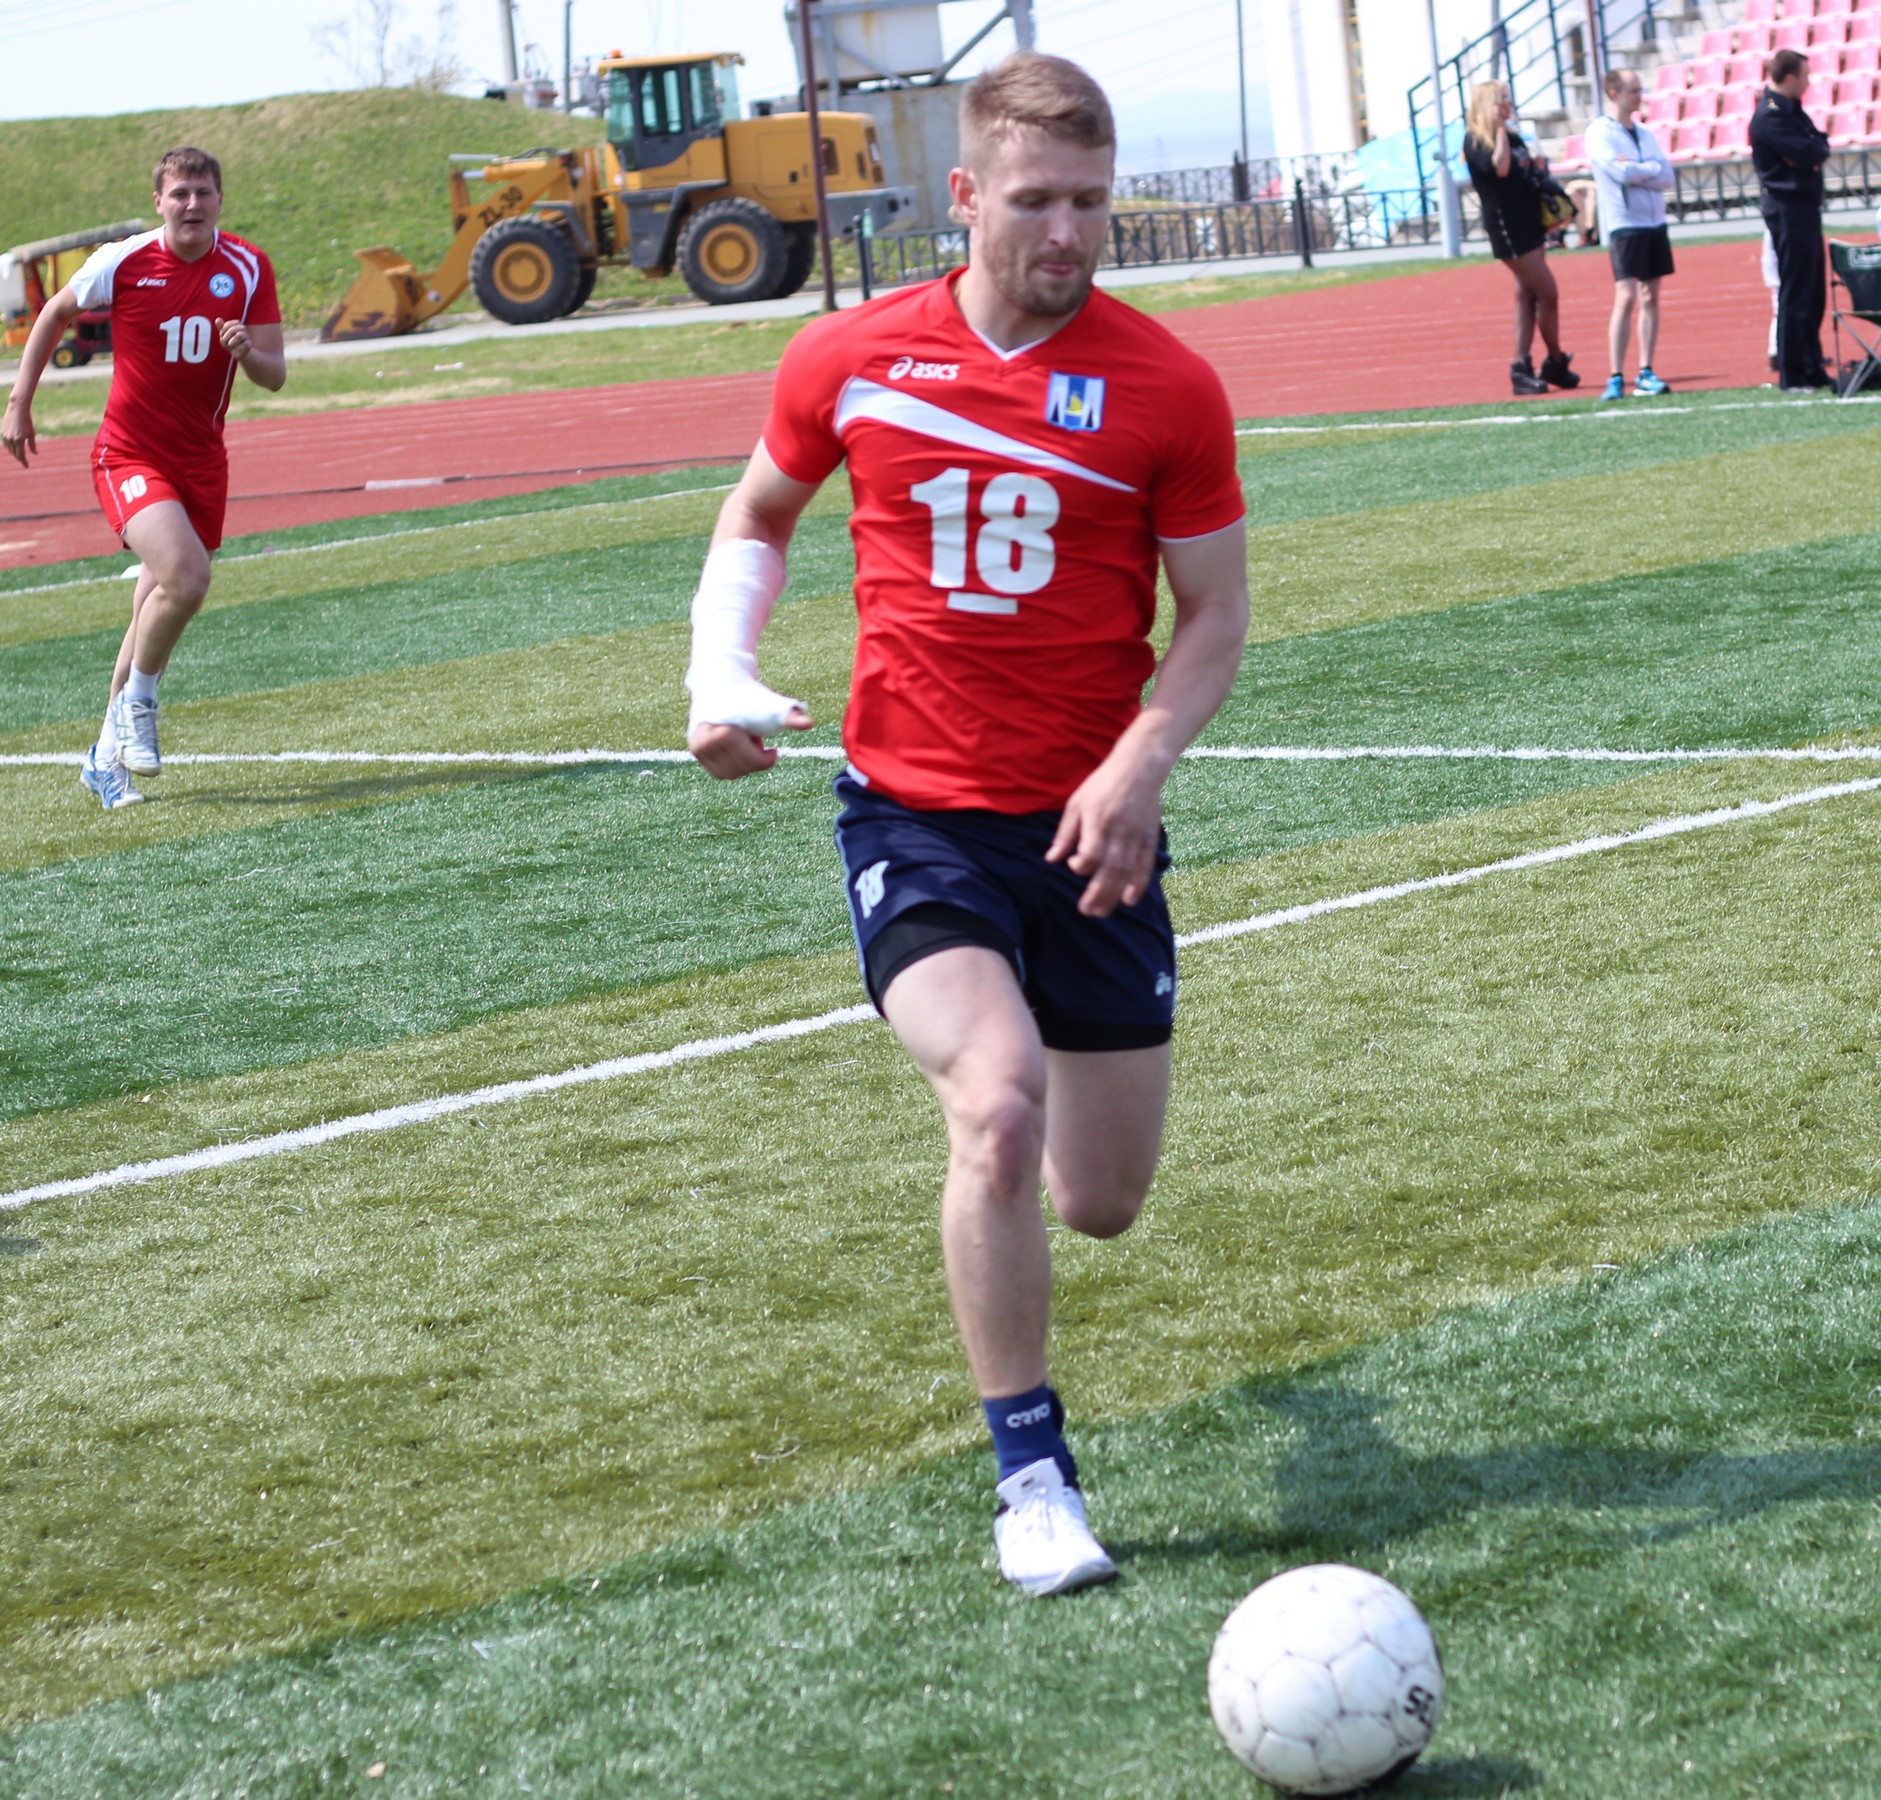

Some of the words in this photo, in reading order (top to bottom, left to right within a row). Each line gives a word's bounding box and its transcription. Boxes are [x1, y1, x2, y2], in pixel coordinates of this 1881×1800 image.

[159, 315, 212, 364] 10
[910, 361, 960, 381] asics
[119, 474, 148, 505] 10
[910, 466, 1061, 595] 18
